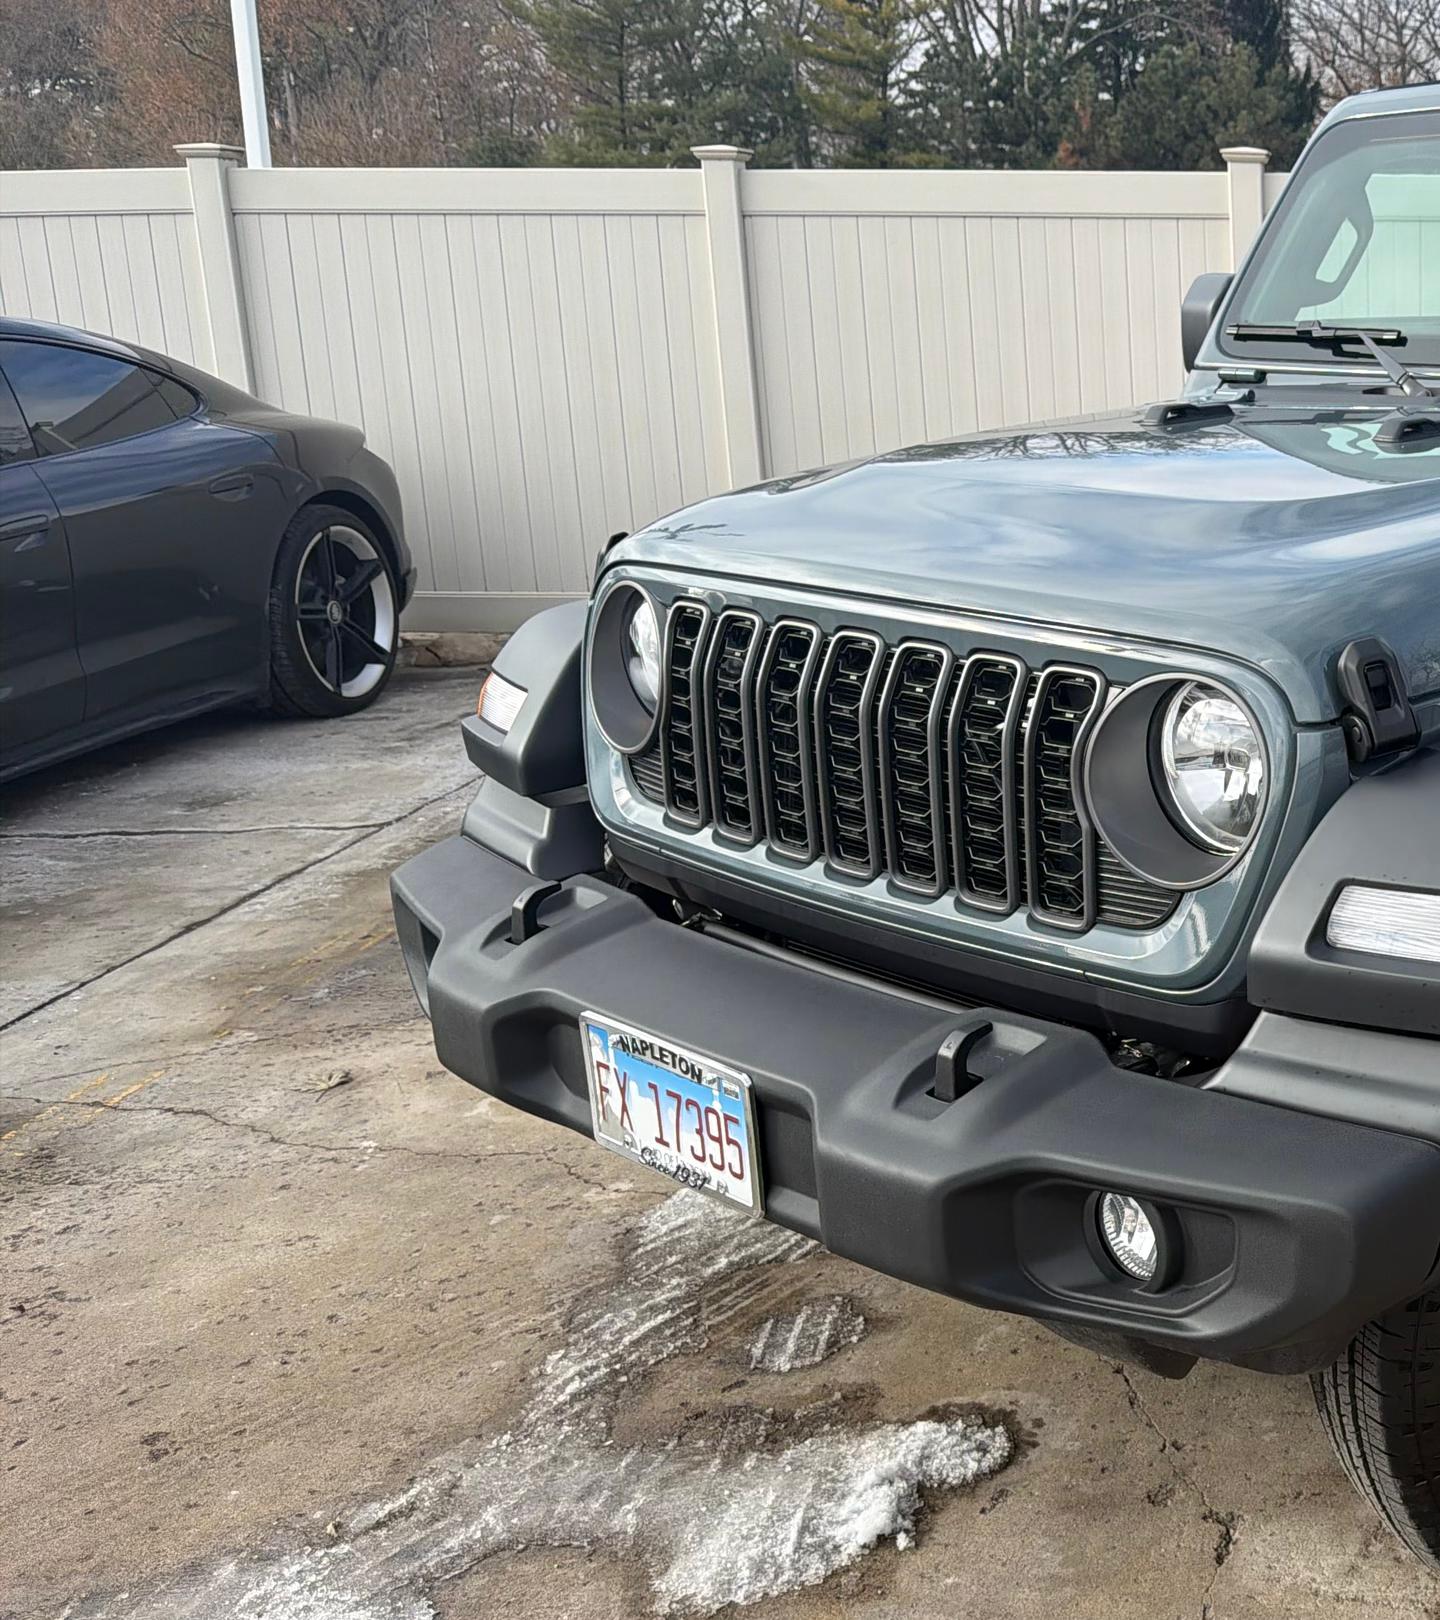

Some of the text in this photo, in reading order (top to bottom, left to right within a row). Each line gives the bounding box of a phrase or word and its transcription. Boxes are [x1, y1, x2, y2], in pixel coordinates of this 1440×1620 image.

[619, 1035, 703, 1083] NAPLETON
[596, 1060, 634, 1132] FX
[648, 1081, 745, 1181] 17395
[638, 1146, 672, 1175] Since
[672, 1164, 708, 1190] 1931
